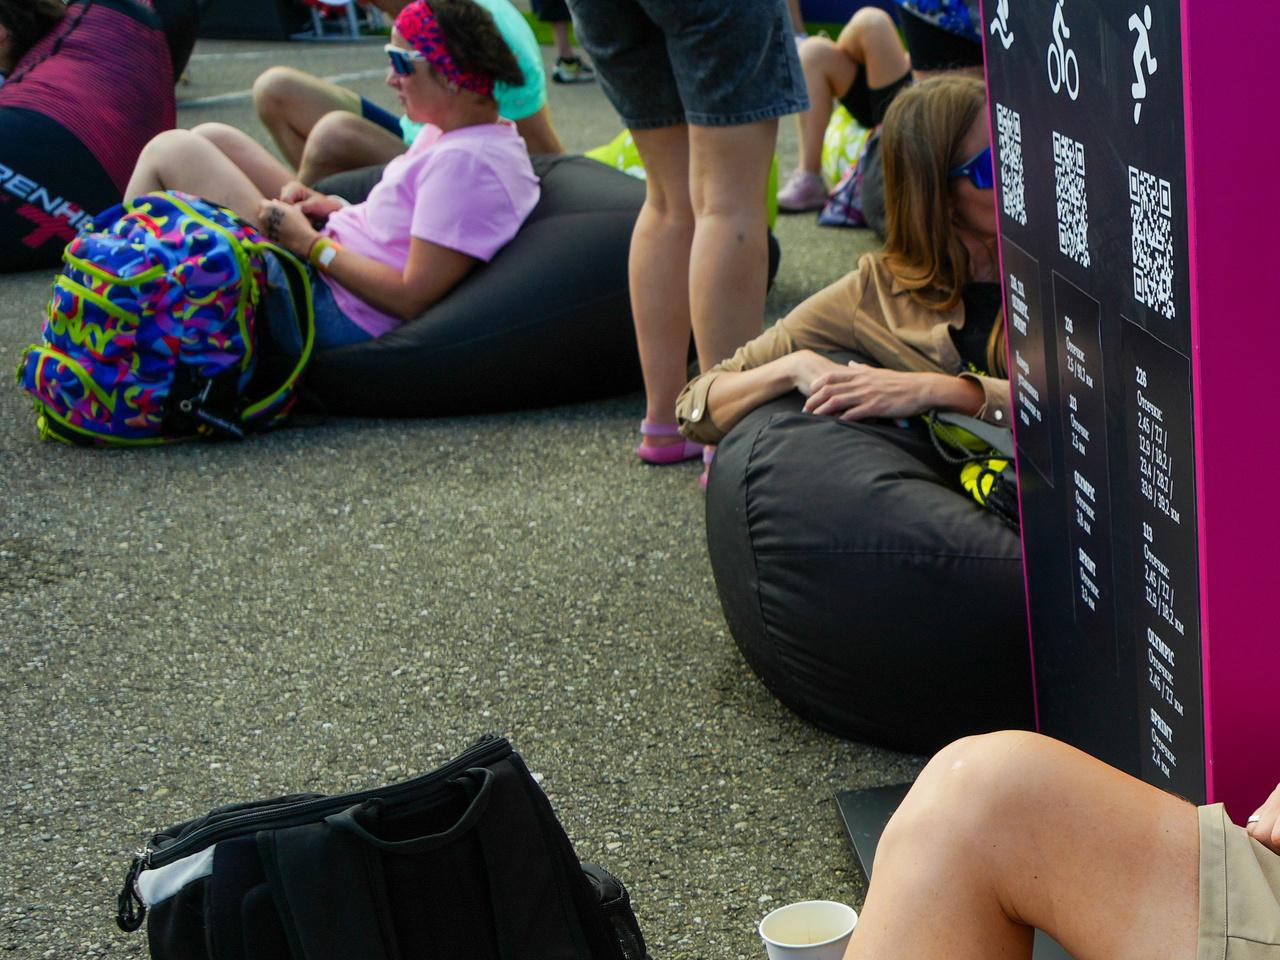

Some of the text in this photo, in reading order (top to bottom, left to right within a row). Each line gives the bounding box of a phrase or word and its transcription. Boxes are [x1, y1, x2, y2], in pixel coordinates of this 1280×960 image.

[1136, 366, 1147, 388] 226
[1143, 522, 1153, 543] 113
[1147, 627, 1175, 667] OLYMPIC
[1150, 708, 1173, 743] SPRINT
